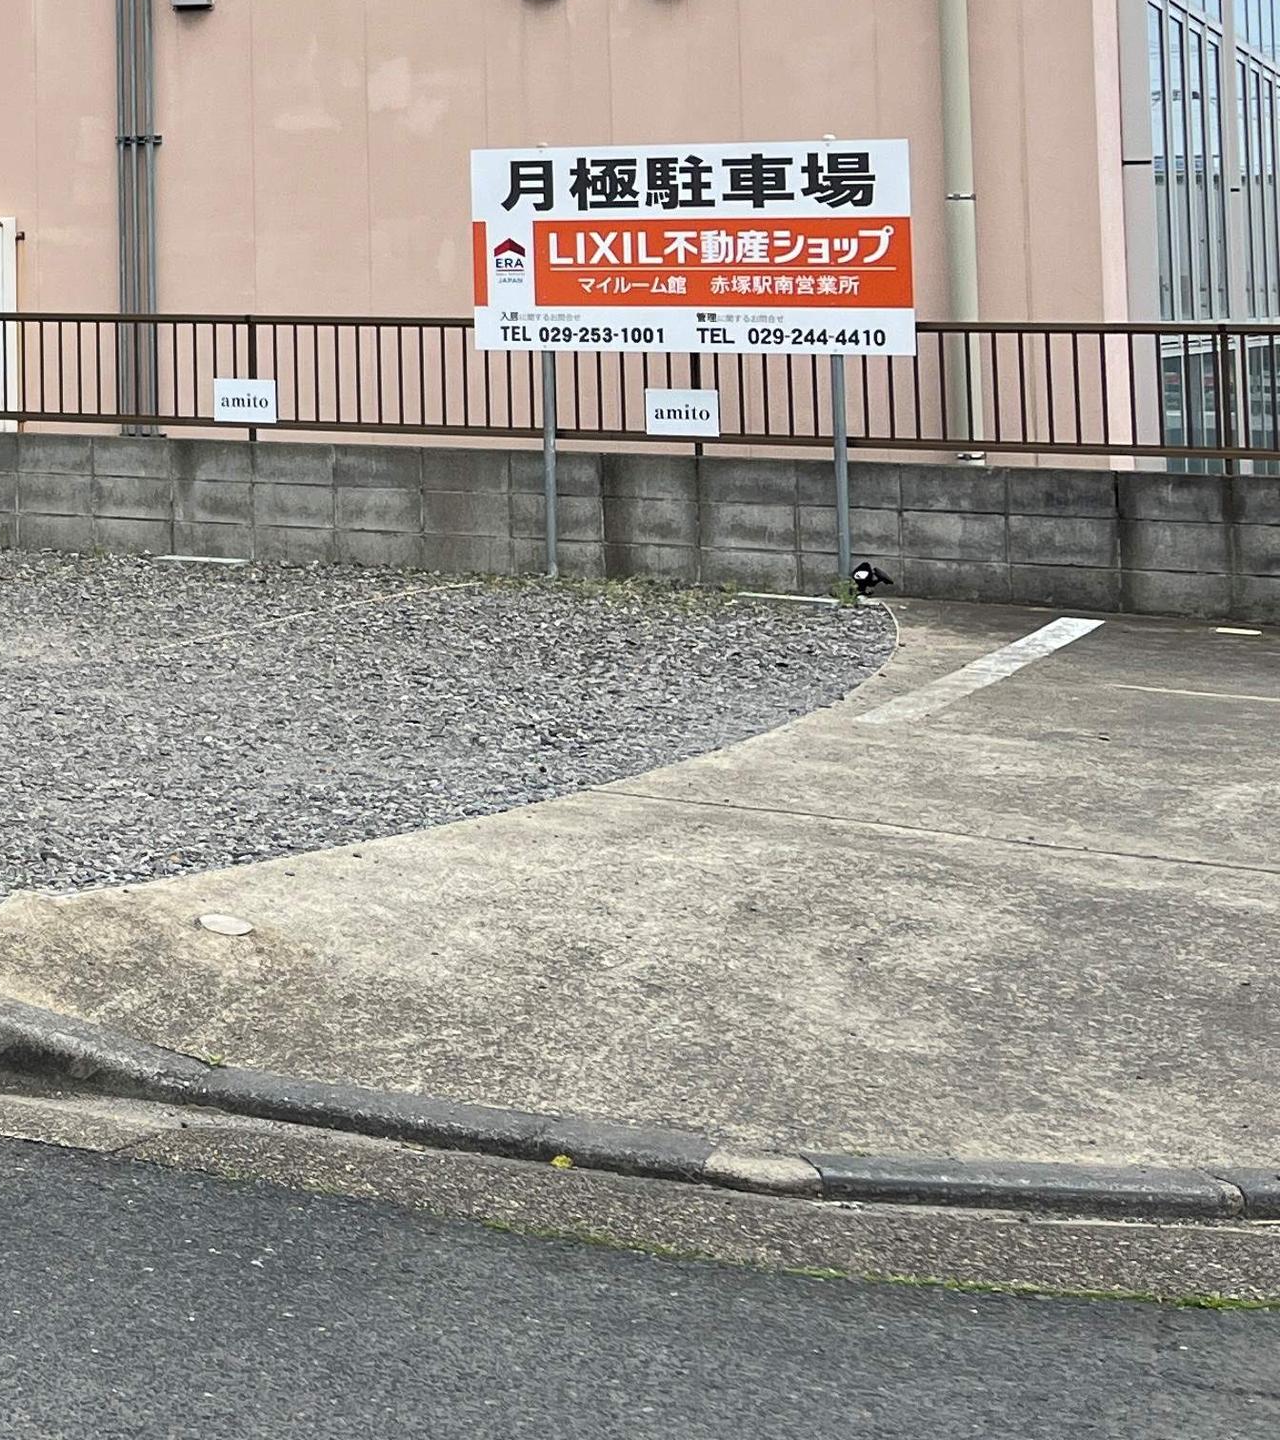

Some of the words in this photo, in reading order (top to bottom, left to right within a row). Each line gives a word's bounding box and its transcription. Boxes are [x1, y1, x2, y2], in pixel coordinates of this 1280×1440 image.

[501, 152, 876, 211] 月極駐車場
[549, 225, 895, 265] LIXIL不動産ショップ
[496, 258, 524, 268] ERA
[577, 275, 687, 295] マイルーム館
[710, 275, 860, 296] 赤塚駅南営業所
[500, 326, 532, 342] TEL
[539, 327, 665, 343] 029-253-1001
[696, 328, 735, 344] TEL
[748, 328, 886, 346] 029-244-4410
[221, 393, 269, 409] amito
[654, 404, 710, 421] amito
